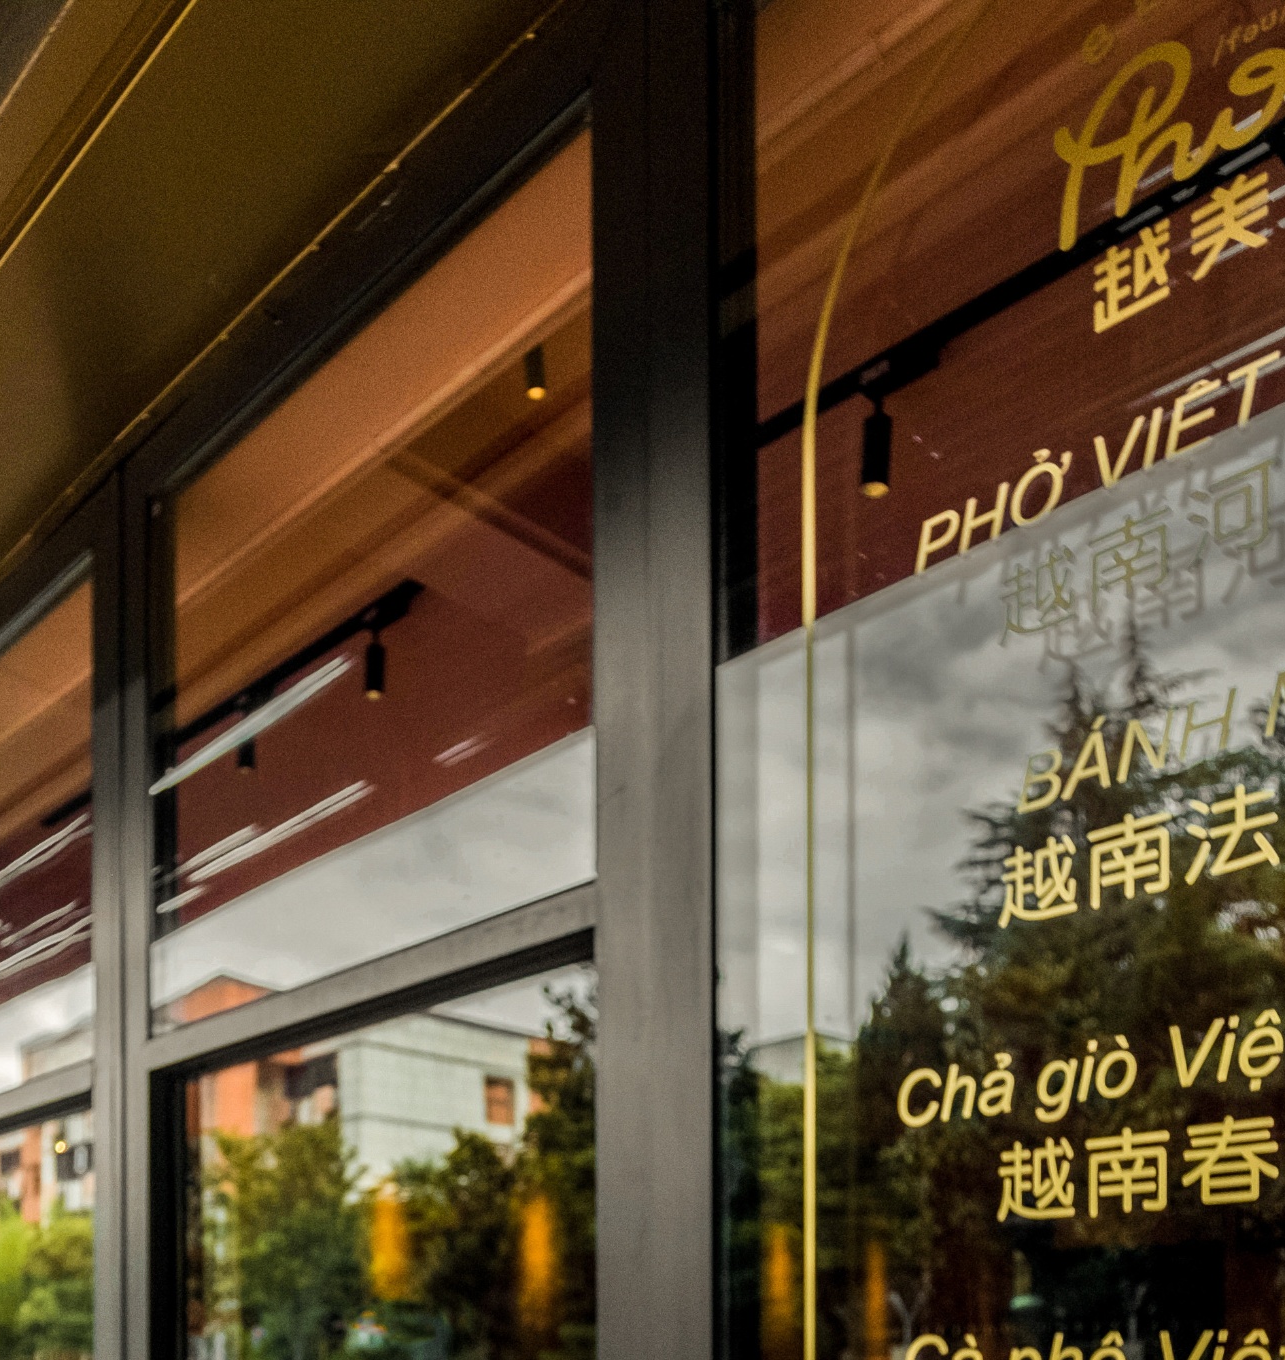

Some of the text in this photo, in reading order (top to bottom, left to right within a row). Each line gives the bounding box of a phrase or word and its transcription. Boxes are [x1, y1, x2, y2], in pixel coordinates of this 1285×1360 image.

[1093, 172, 1270, 334] 越美
[915, 448, 1072, 576] PHỞ
[1017, 680, 1238, 815] BÁNH
[897, 1052, 1017, 1127] Chả
[1036, 1033, 1138, 1122] giò
